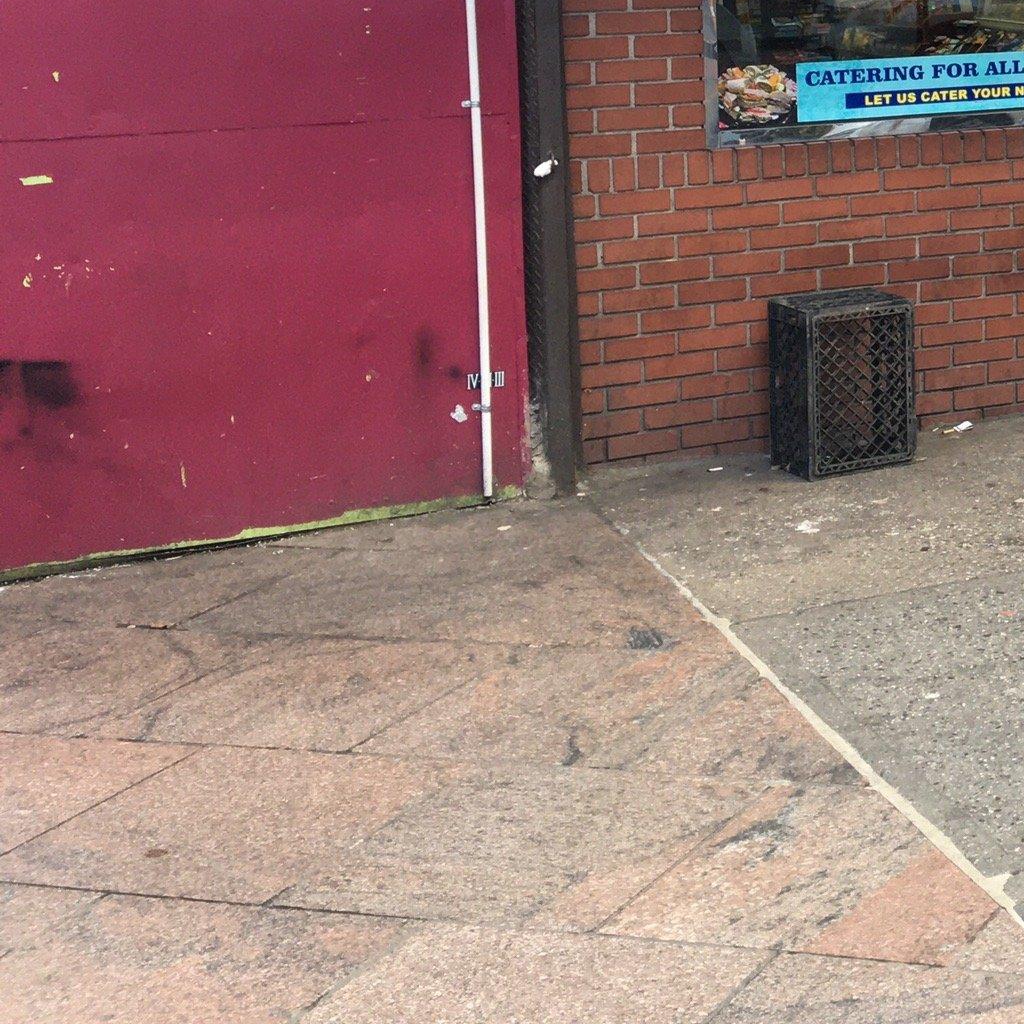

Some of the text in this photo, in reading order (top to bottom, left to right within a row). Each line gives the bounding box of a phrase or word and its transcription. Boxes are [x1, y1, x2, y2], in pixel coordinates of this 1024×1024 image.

[804, 64, 925, 87] CATERING
[931, 62, 979, 79] FOR
[864, 93, 893, 106] LET
[896, 92, 917, 104] US
[920, 89, 968, 103] CATER
[972, 86, 1011, 99] YOUR
